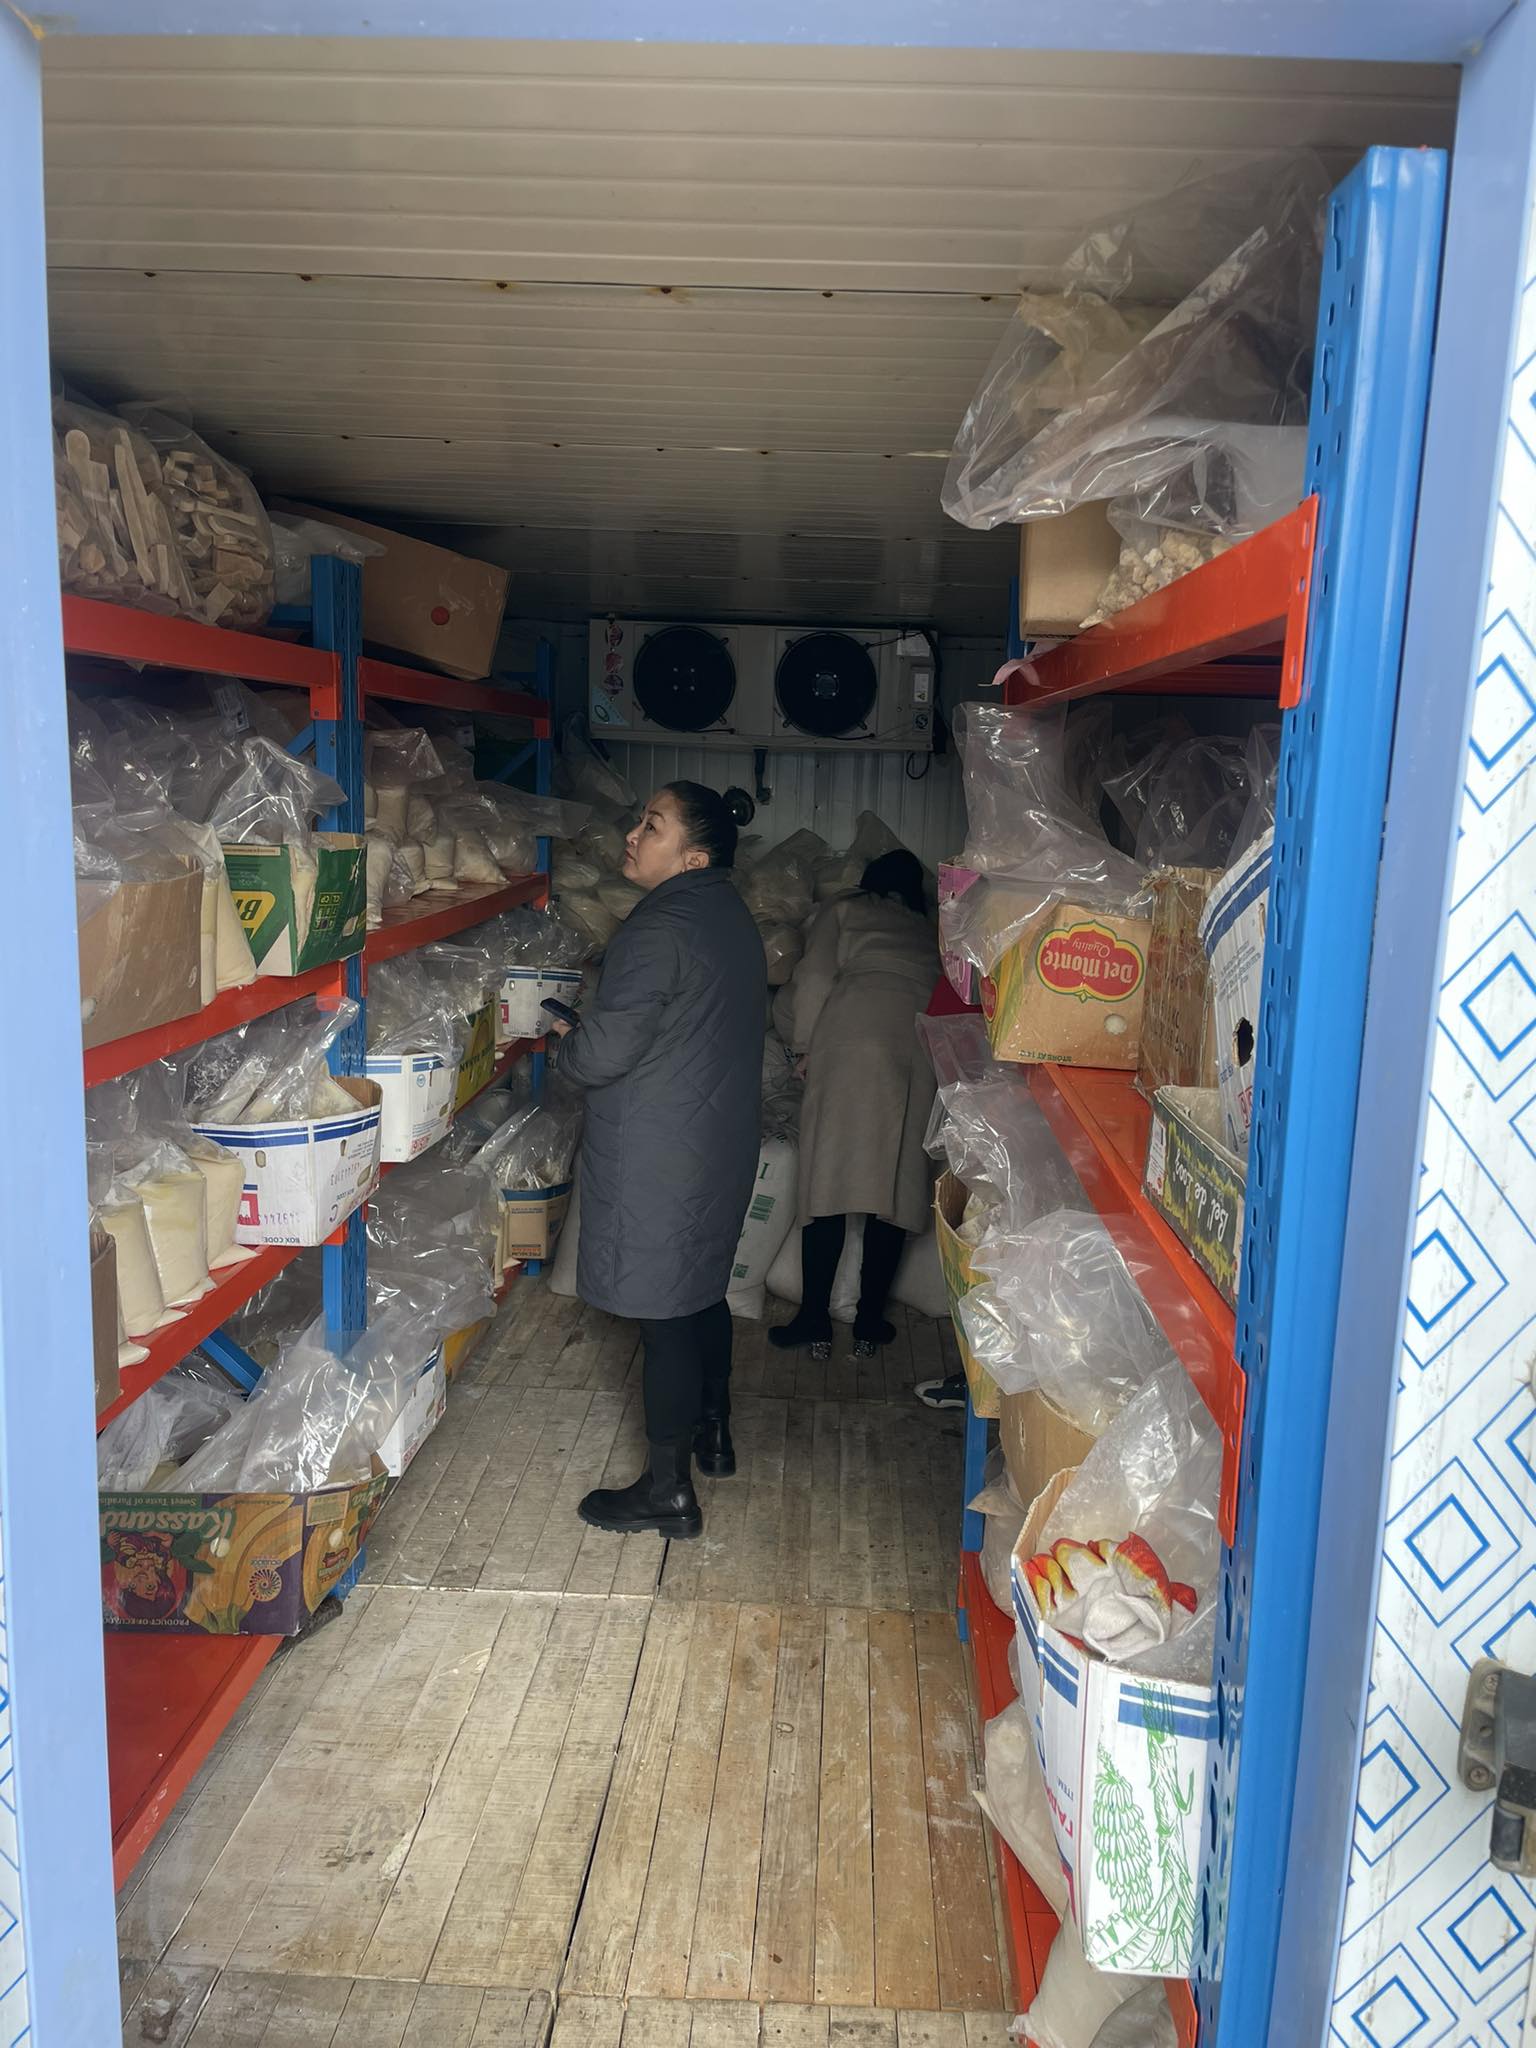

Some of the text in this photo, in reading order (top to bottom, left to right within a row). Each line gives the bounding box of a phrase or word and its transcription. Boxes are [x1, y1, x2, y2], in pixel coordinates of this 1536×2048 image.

[1072, 938, 1110, 958] Quality
[1043, 950, 1134, 984] Del Monte
[134, 1497, 144, 1506] of
[145, 1497, 167, 1506] Taste
[170, 1497, 197, 1506] Sweet
[151, 1617, 190, 1626] PRODUCT
